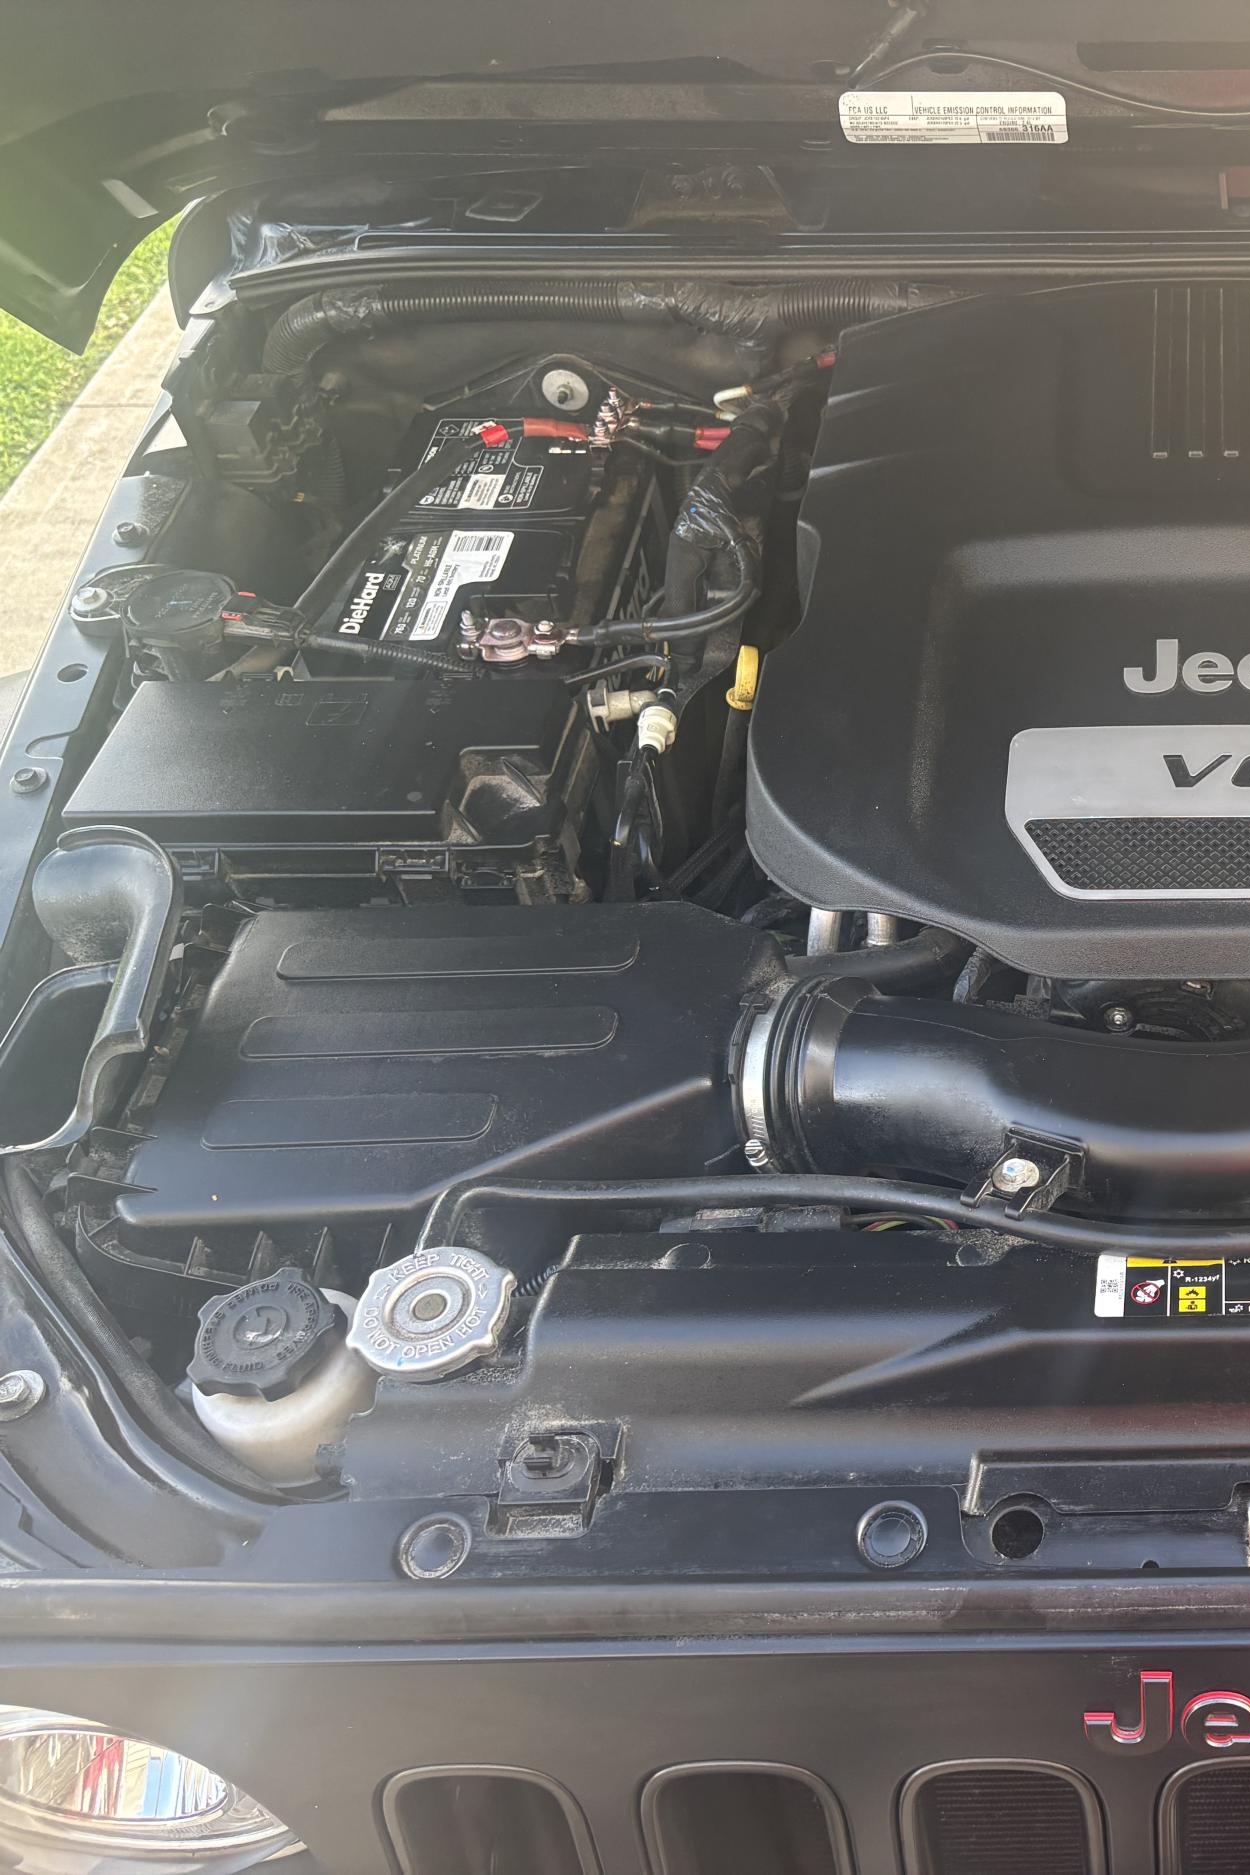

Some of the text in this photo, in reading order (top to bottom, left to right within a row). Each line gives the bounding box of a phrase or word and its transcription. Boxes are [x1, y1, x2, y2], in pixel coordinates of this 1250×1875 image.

[848, 106, 888, 114] FCA US LLC
[914, 106, 1052, 115] VEHICLE EMISSION CONTROL INFORMATION
[338, 572, 385, 634] DieHard
[388, 1253, 491, 1283] KEEP TIGHT
[1185, 1274, 1220, 1283] R-1234yf
[363, 1306, 488, 1359] DO NOT OPEN HOT
